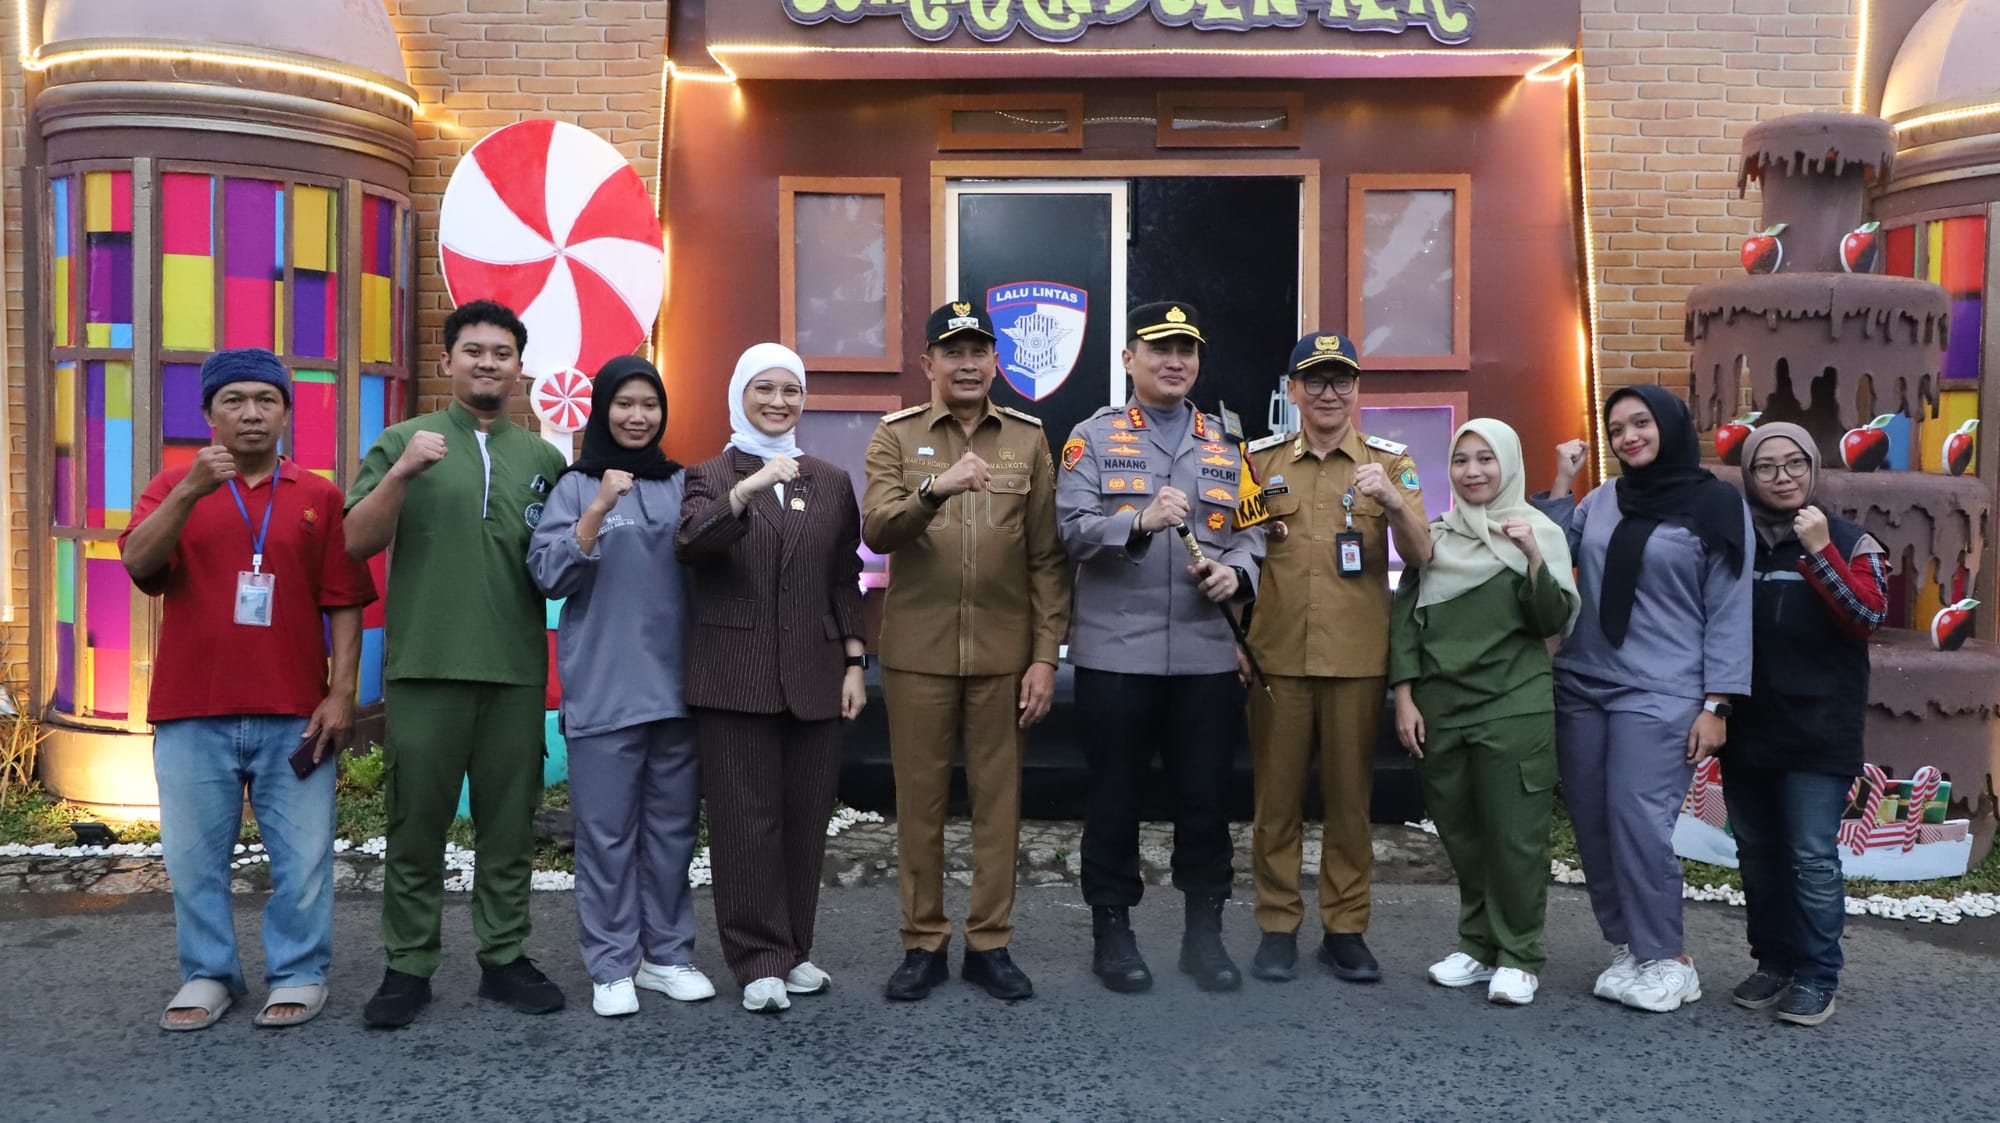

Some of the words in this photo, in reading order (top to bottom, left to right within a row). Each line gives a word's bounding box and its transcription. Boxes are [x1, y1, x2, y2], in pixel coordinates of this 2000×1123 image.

[996, 288, 1029, 302] LALU
[1032, 288, 1078, 303] LINTAS
[1104, 458, 1147, 471] NANANG
[1202, 467, 1236, 482] POLRI
